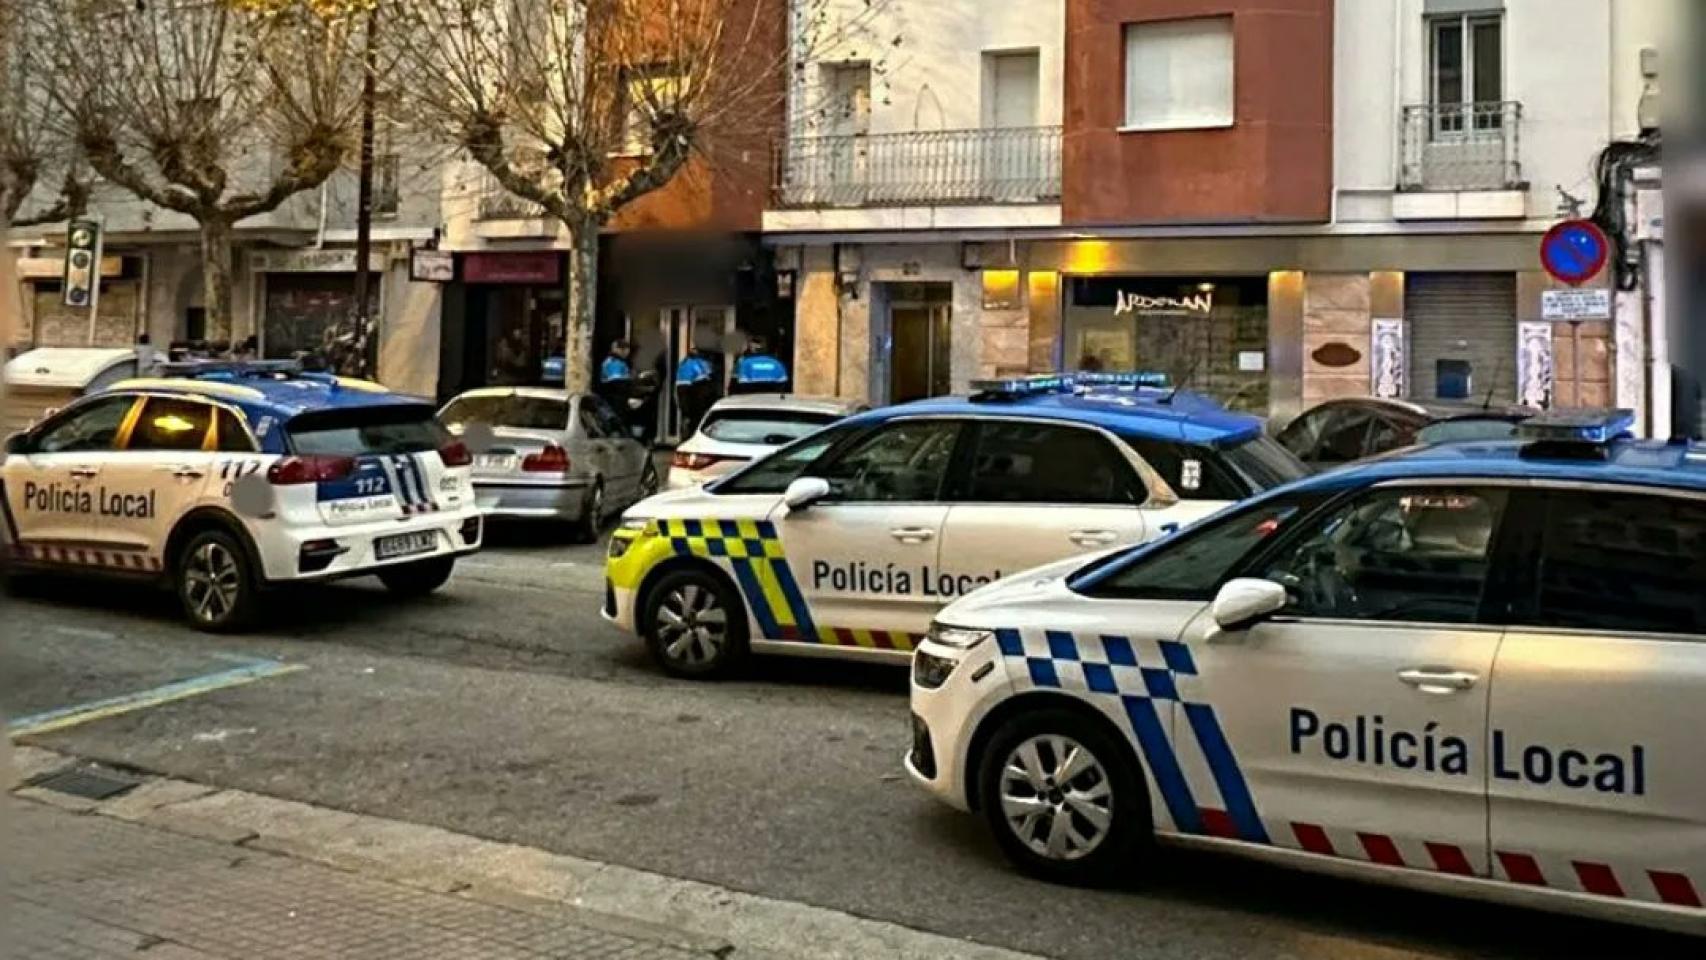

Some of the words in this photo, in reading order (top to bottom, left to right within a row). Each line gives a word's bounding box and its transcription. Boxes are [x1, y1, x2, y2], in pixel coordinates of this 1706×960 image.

[24, 480, 91, 513] Policía
[100, 486, 156, 518] Local
[355, 477, 384, 494] 112
[813, 559, 911, 594] Policía
[922, 565, 1001, 597] Loc
[1289, 707, 1468, 776] Policía
[1493, 729, 1645, 795] Local
